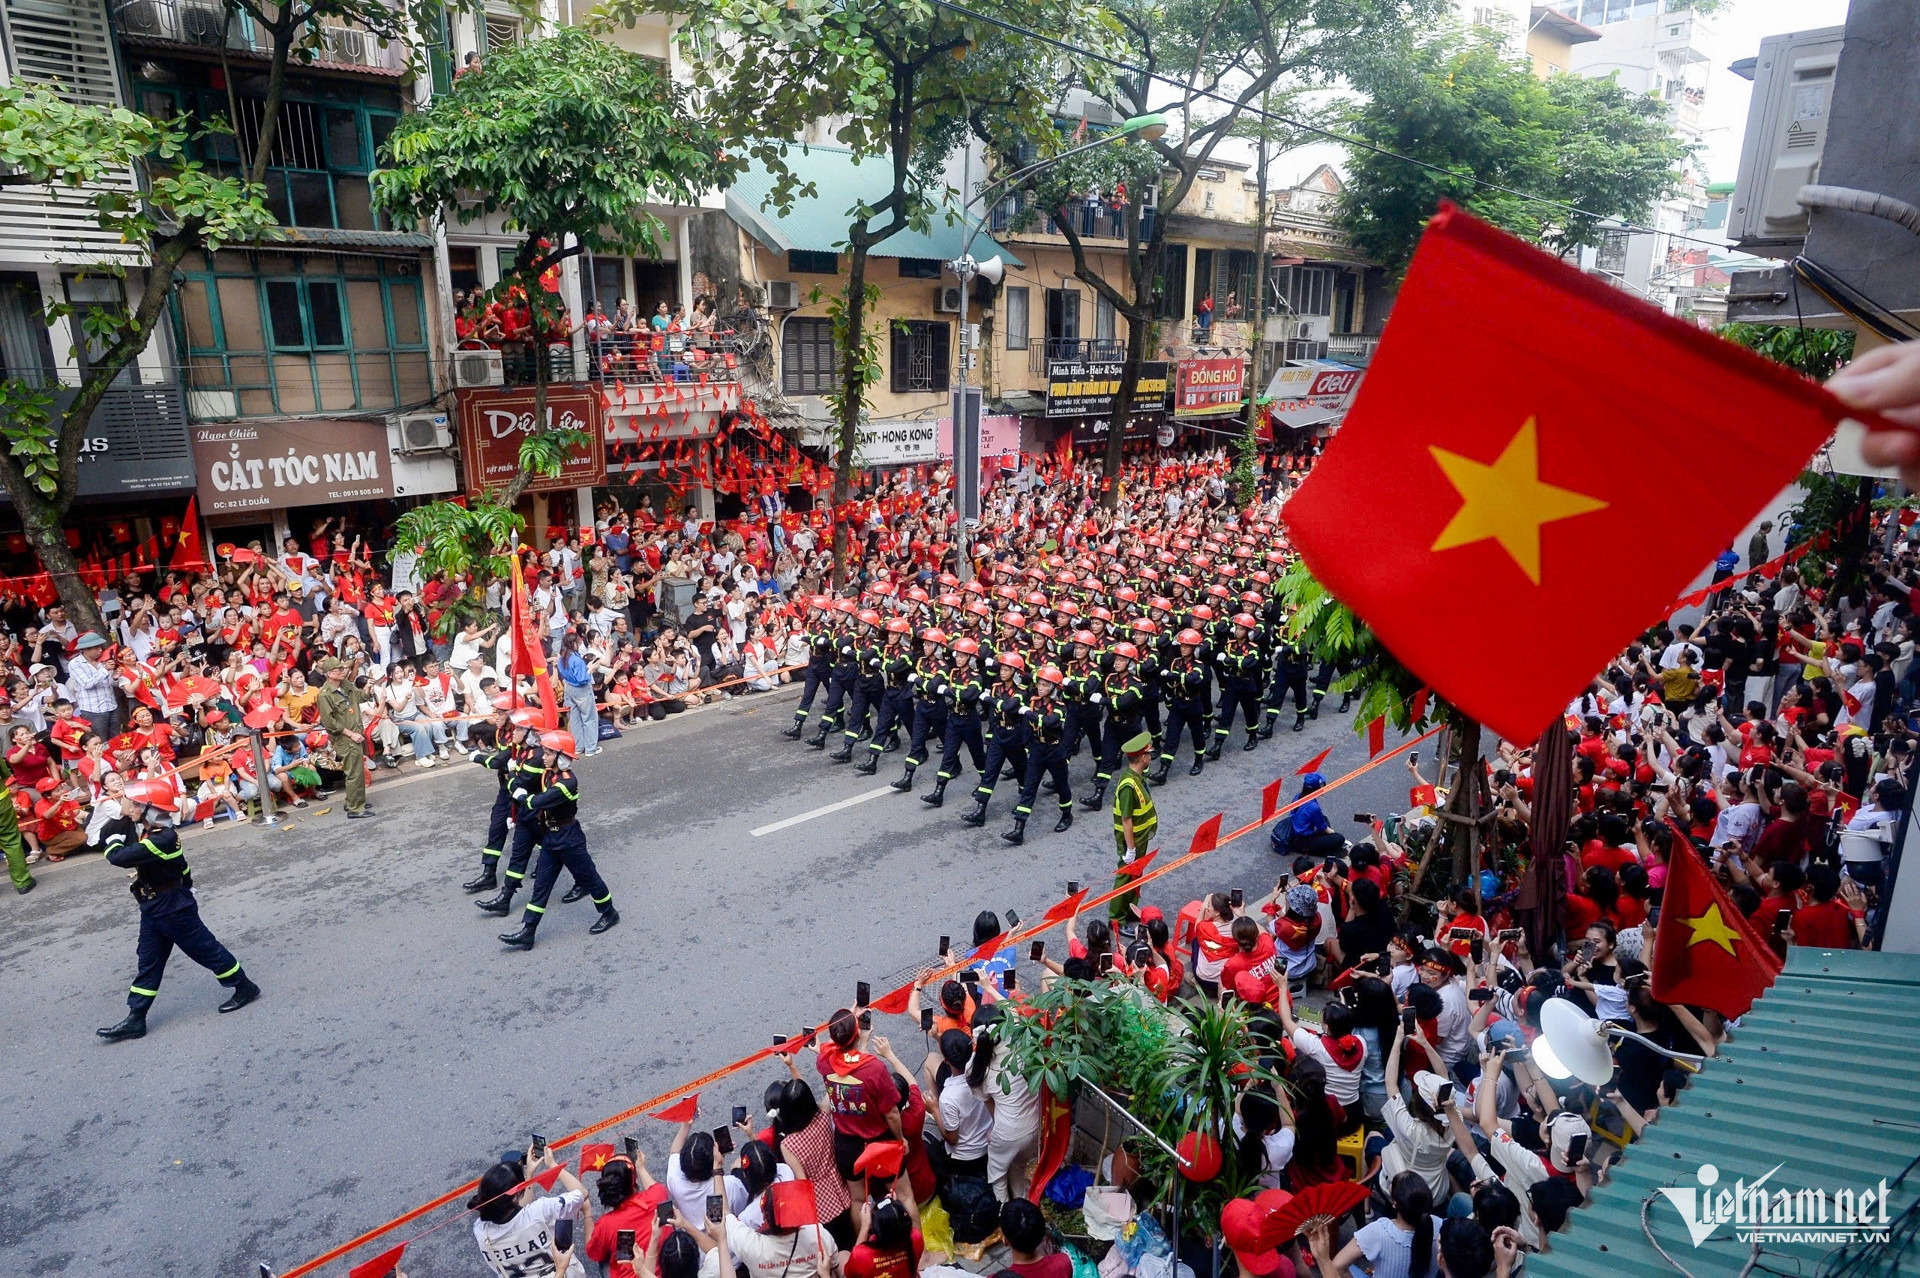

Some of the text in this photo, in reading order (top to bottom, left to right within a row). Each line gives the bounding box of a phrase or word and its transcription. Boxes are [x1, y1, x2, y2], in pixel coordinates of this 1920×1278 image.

[1052, 366, 1069, 376] Minh
[1090, 365, 1104, 374] Hair
[1104, 365, 1110, 374] &
[1110, 364, 1122, 376] Spa
[1191, 364, 1237, 384] ĐỒNG HỒ
[1317, 373, 1354, 392] deli
[484, 410, 536, 438] Diệ
[229, 428, 257, 439] Chiến
[909, 428, 932, 442] KONG
[211, 443, 379, 492] CẮT TÓC NAM
[238, 498, 248, 507] LÊ
[249, 495, 269, 506] DUẨN
